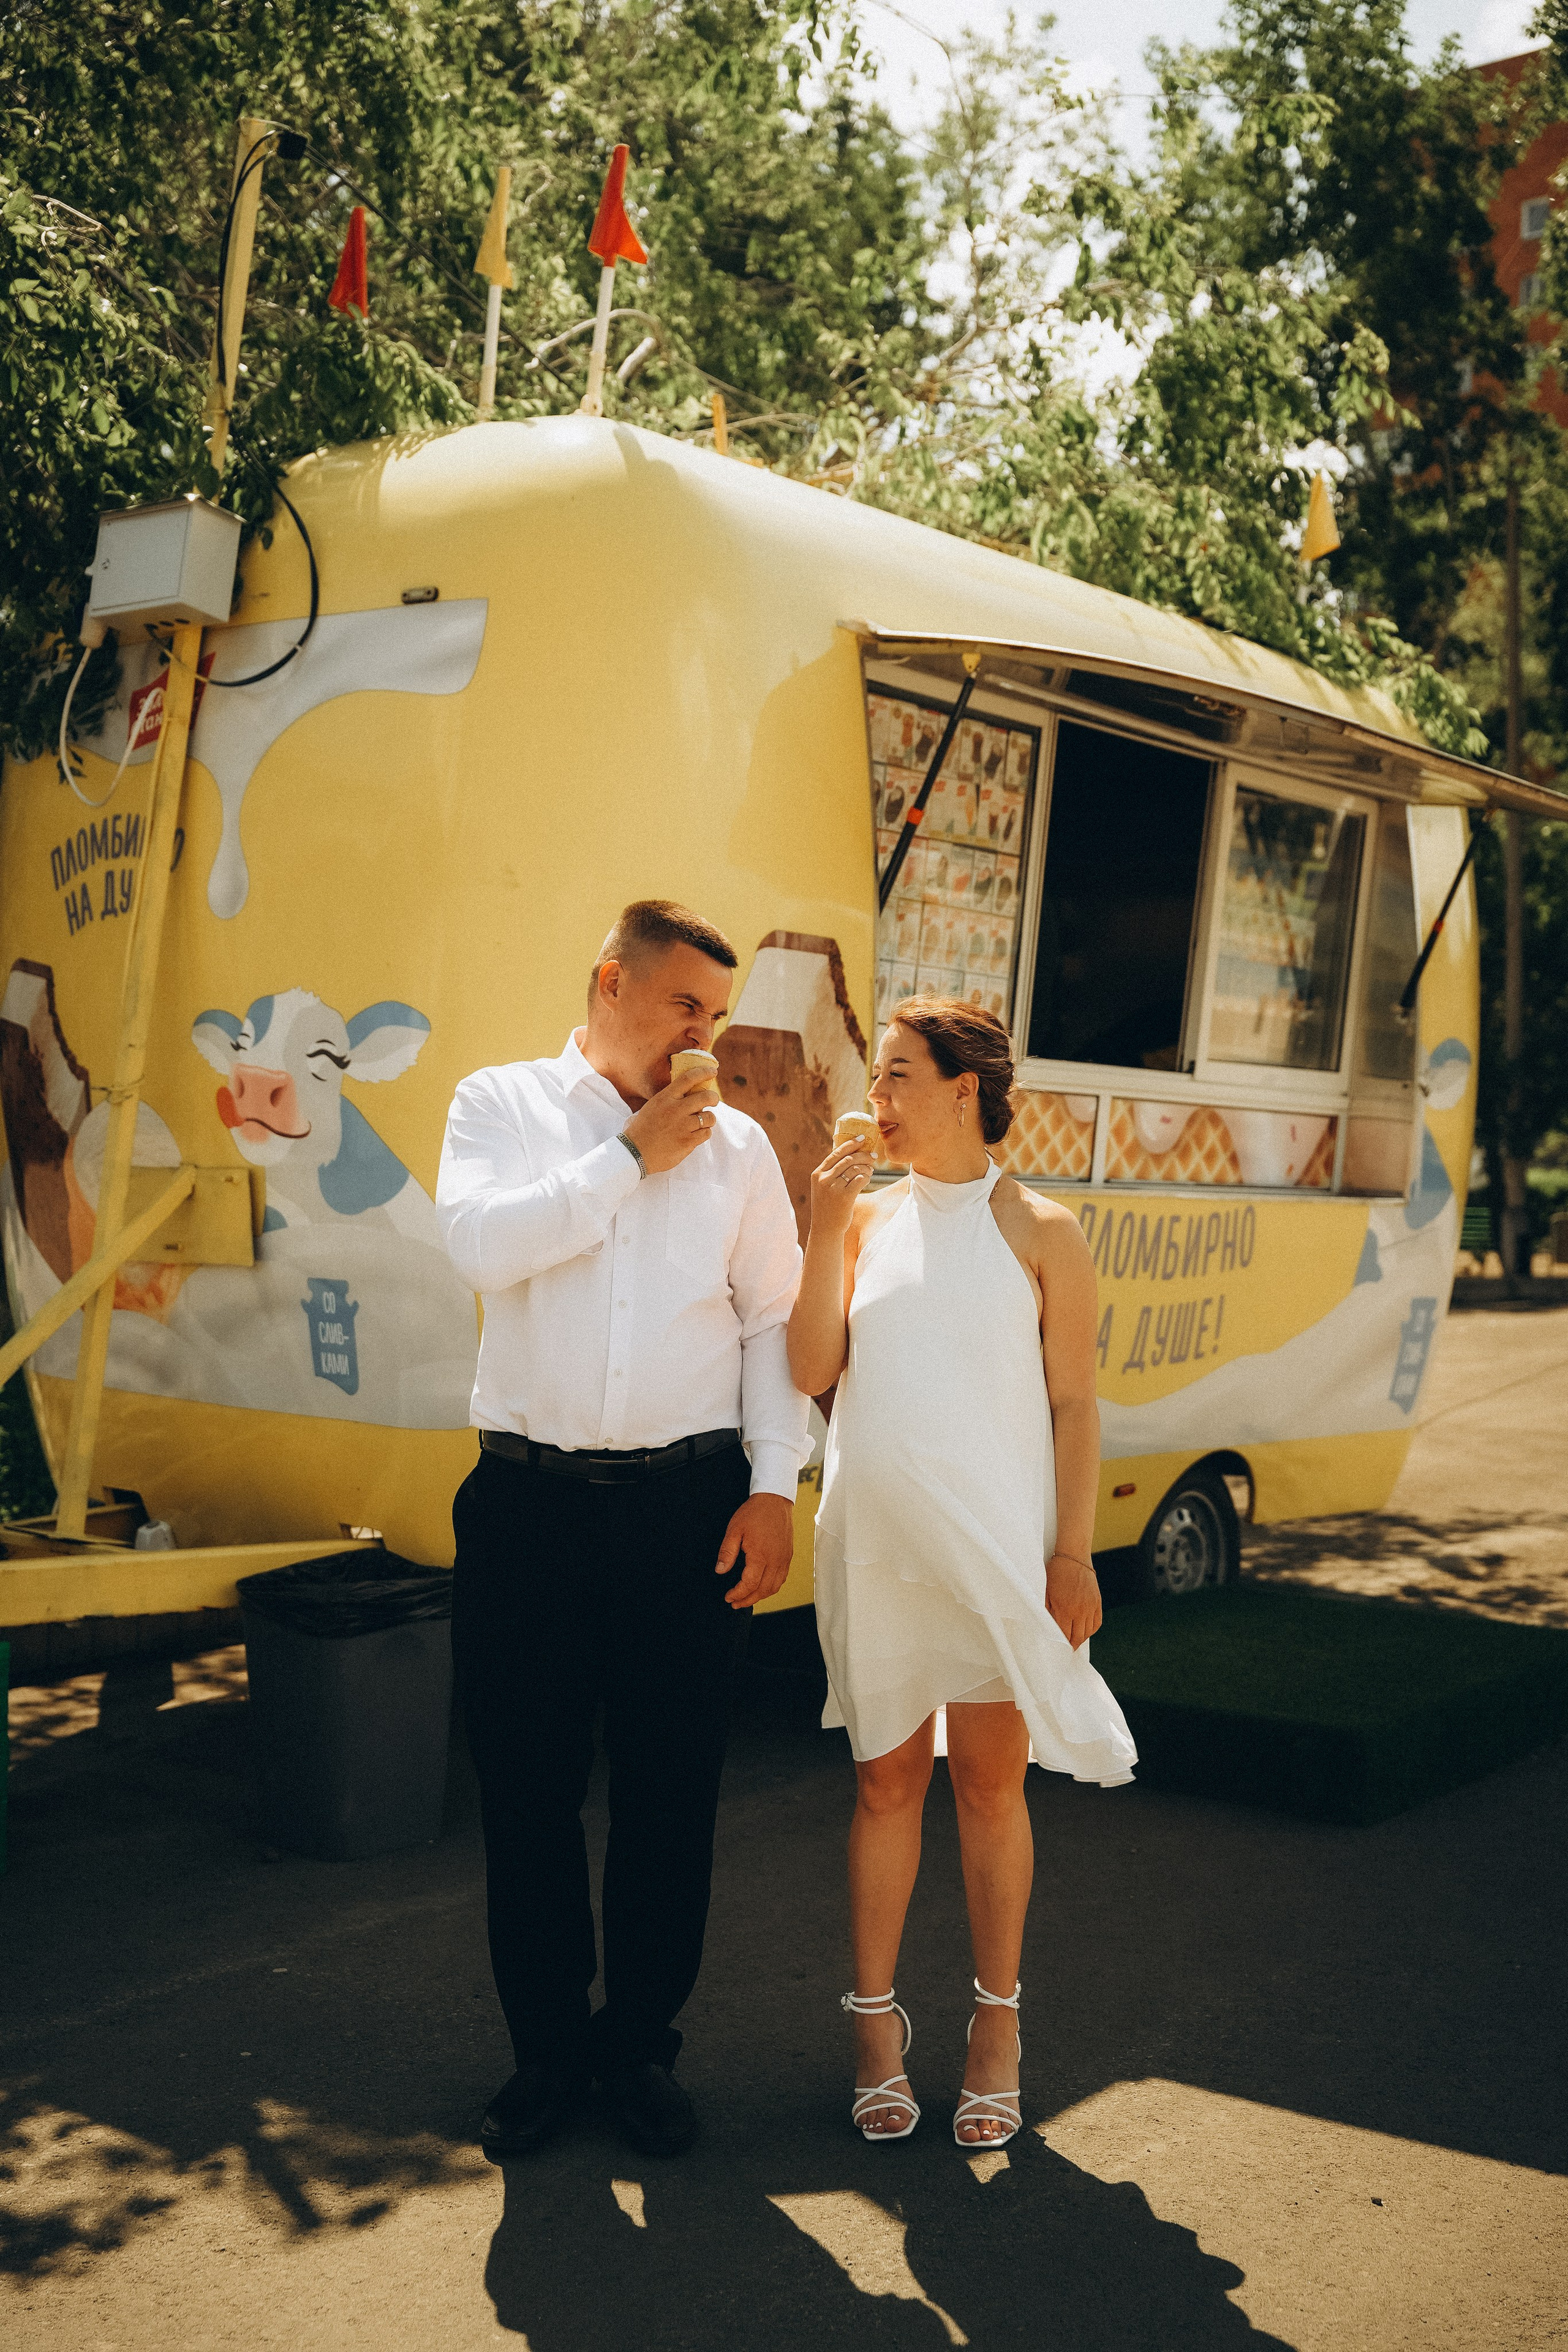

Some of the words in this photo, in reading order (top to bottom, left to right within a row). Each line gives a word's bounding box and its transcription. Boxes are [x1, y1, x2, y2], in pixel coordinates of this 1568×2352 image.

[65, 882, 93, 936] НА
[323, 1291, 336, 1314] СО
[1122, 1294, 1225, 1375] ДУШЕ!
[320, 1352, 350, 1375] КАМИ
